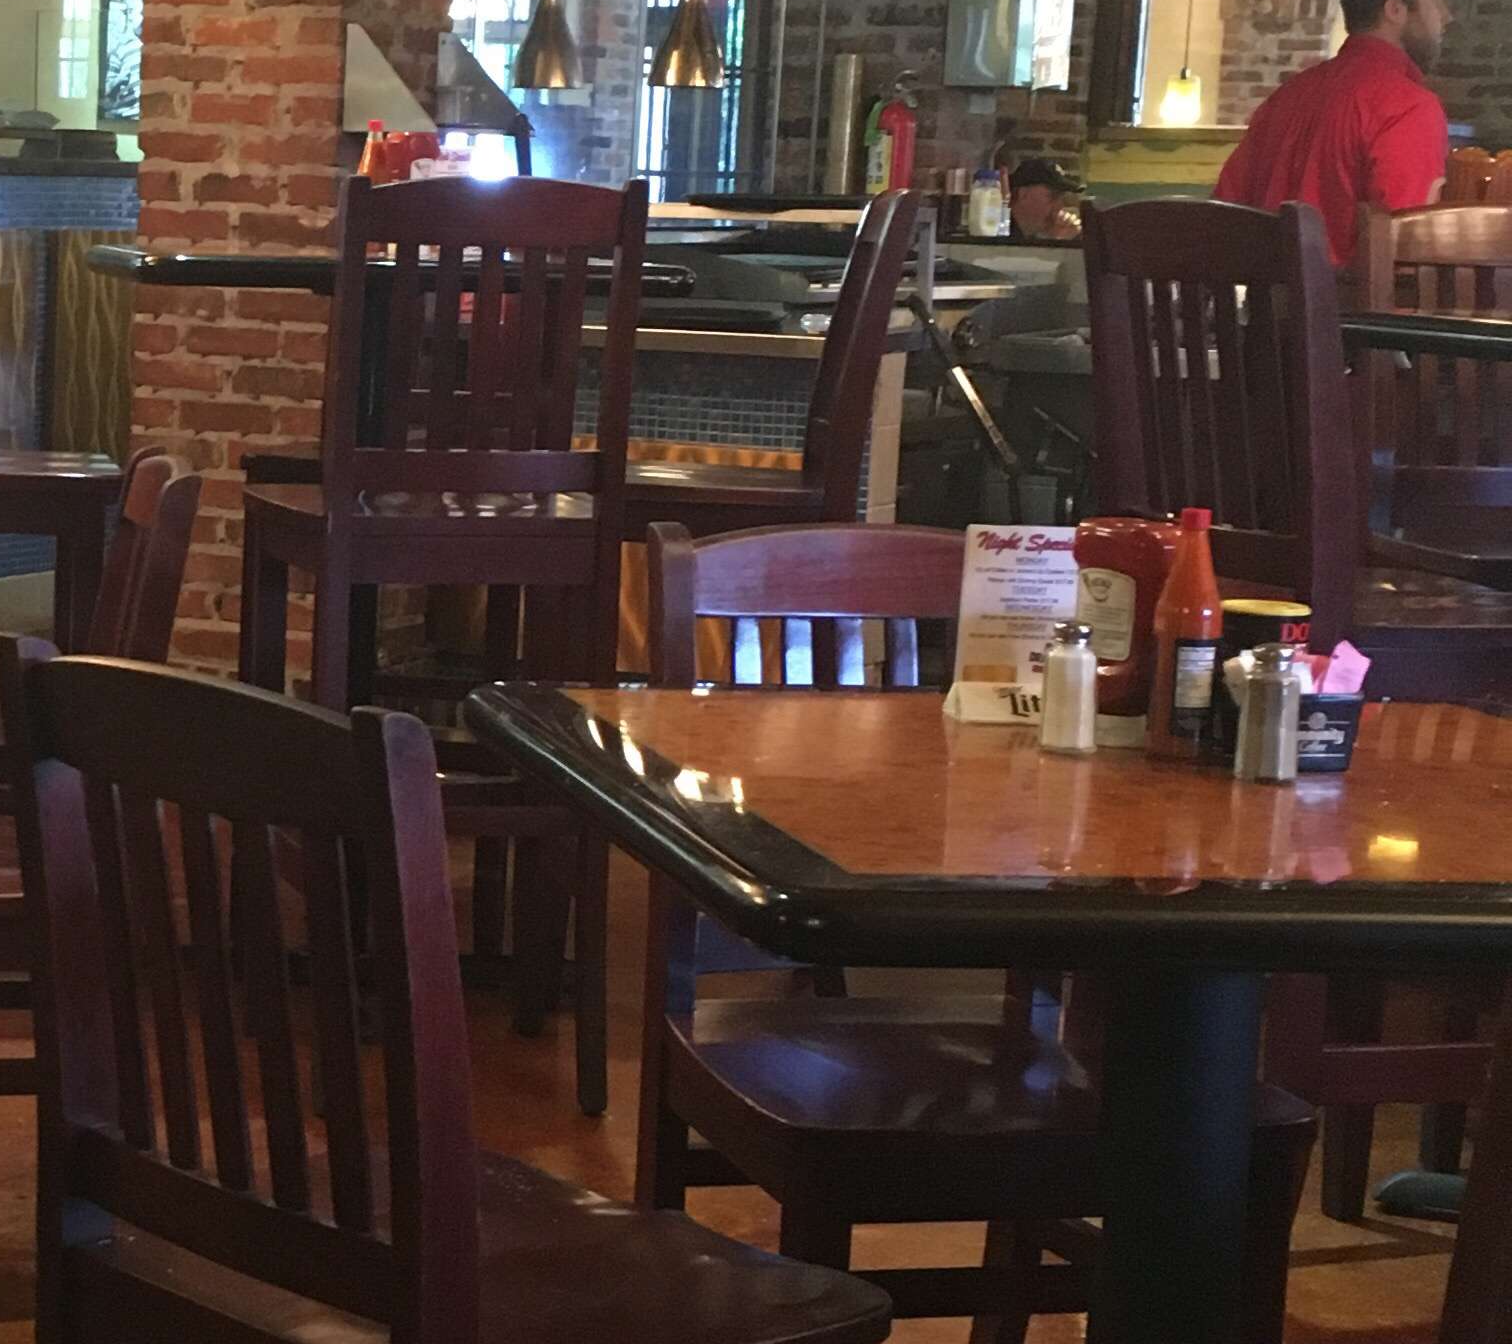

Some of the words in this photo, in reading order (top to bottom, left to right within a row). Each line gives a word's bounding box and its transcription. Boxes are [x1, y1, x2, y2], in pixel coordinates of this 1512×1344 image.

[976, 531, 1023, 555] Night
[1024, 533, 1075, 554] Speci
[999, 690, 1041, 718] Lit
